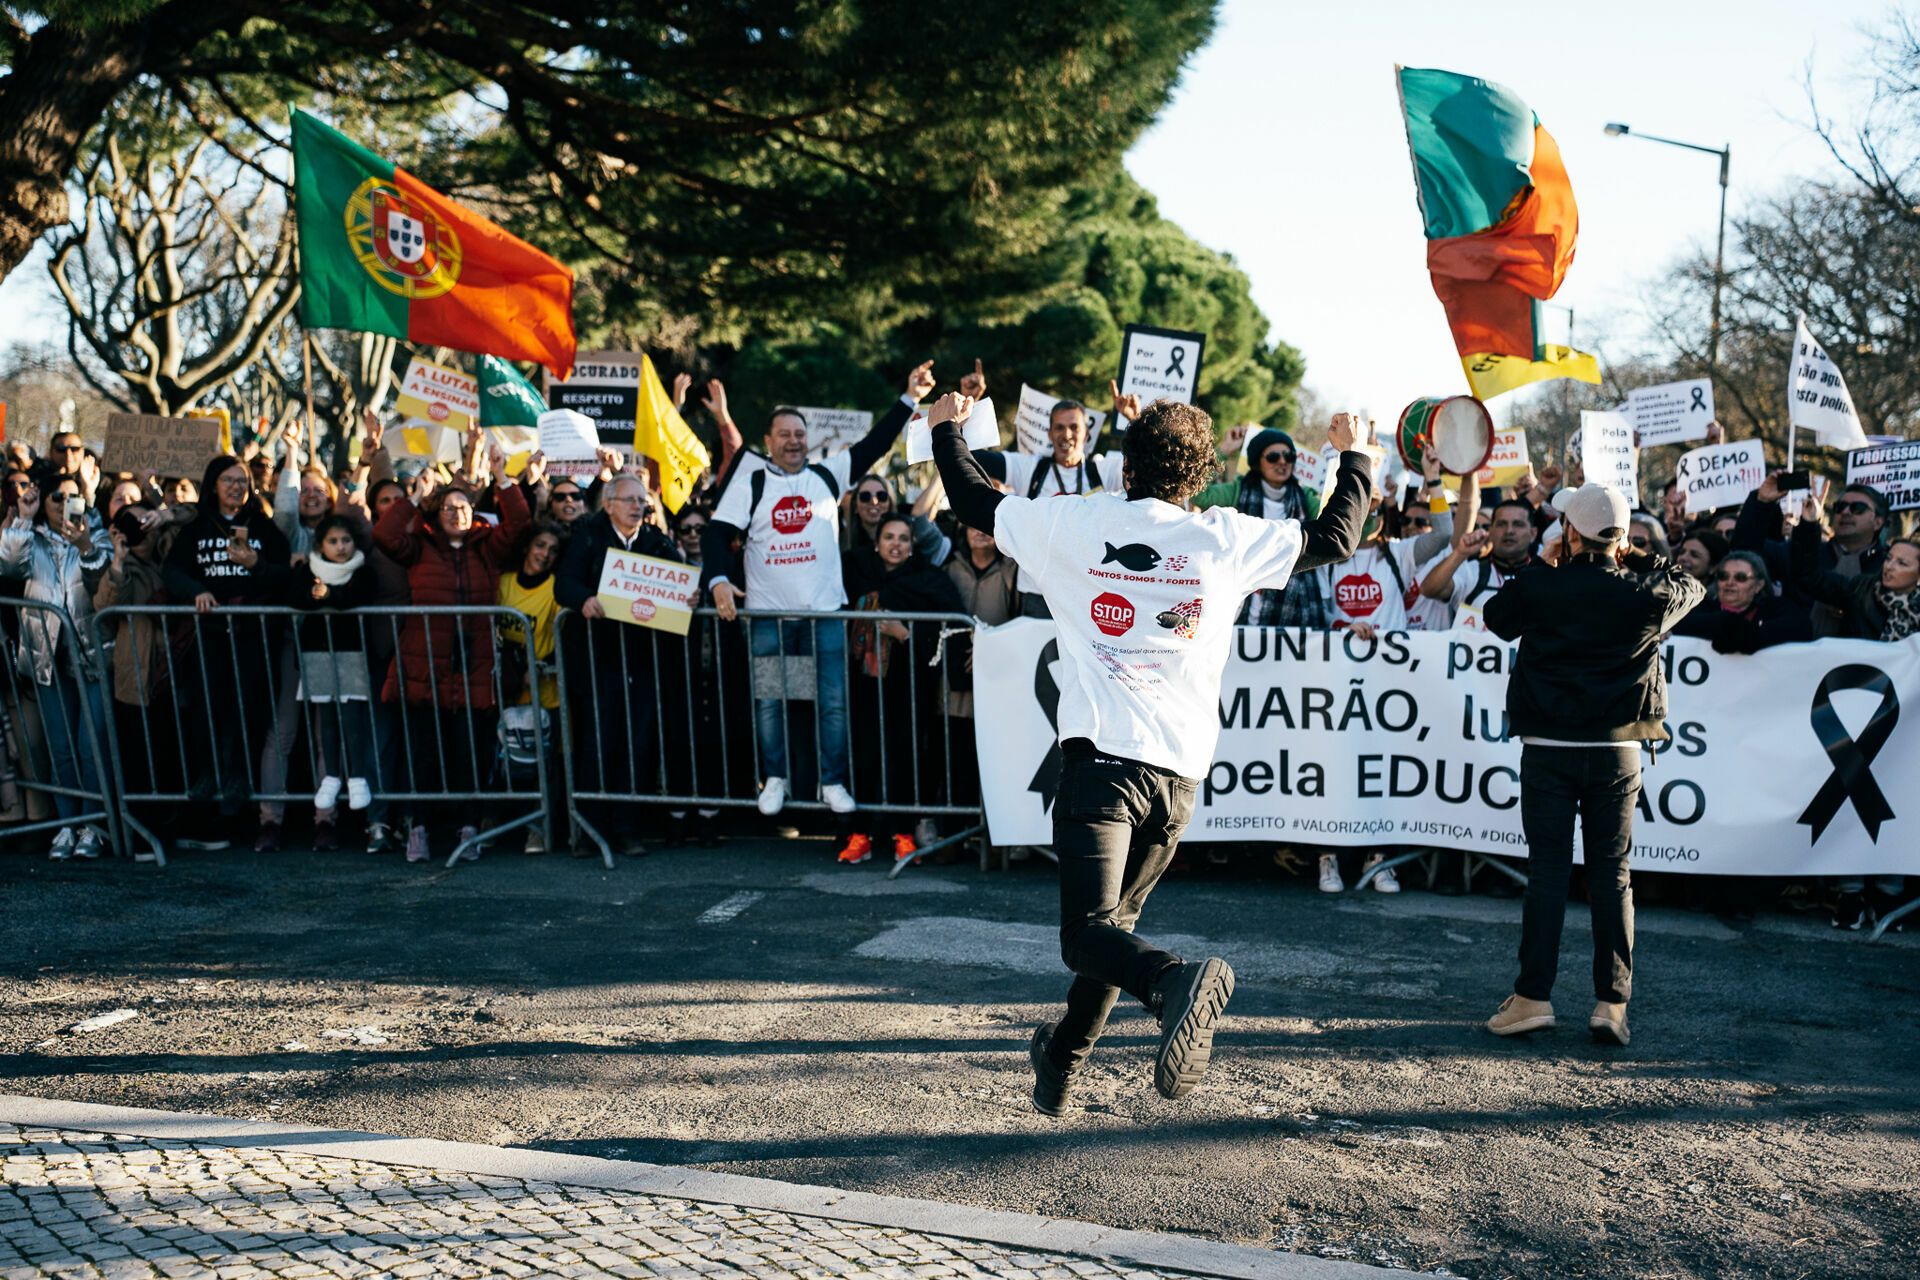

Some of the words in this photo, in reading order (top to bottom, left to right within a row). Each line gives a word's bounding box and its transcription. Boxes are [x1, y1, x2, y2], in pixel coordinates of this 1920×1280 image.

[1136, 348, 1155, 359] Por
[415, 366, 426, 379] A
[1134, 364, 1158, 374] uma
[1131, 377, 1187, 393] Educação
[562, 393, 625, 405] RESPEITO
[577, 406, 604, 418] AOS
[1698, 451, 1750, 473] DEMO
[1855, 445, 1920, 466] PROFESSO
[1615, 461, 1631, 471] da
[779, 541, 811, 551] LUTAR
[612, 558, 625, 571] A
[631, 562, 690, 586] LUTAR
[1088, 567, 1122, 580] JUNTOS
[1123, 574, 1156, 584] SOMOS
[1165, 578, 1201, 586] FORTES
[608, 578, 618, 588] A
[623, 581, 687, 604] ENSINAR
[1093, 602, 1133, 623] S.T.O.P.
[1236, 626, 1422, 674] UNTOS,
[1202, 749, 1325, 807] pela
[1205, 816, 1286, 830] #RESPEITO
[1292, 819, 1395, 837] #VALORIZAÇÃO
[1400, 820, 1473, 840] #JUSTIÇA
[1480, 828, 1530, 846] #DIGN
[1633, 844, 1701, 863] ITUIÇÃO
